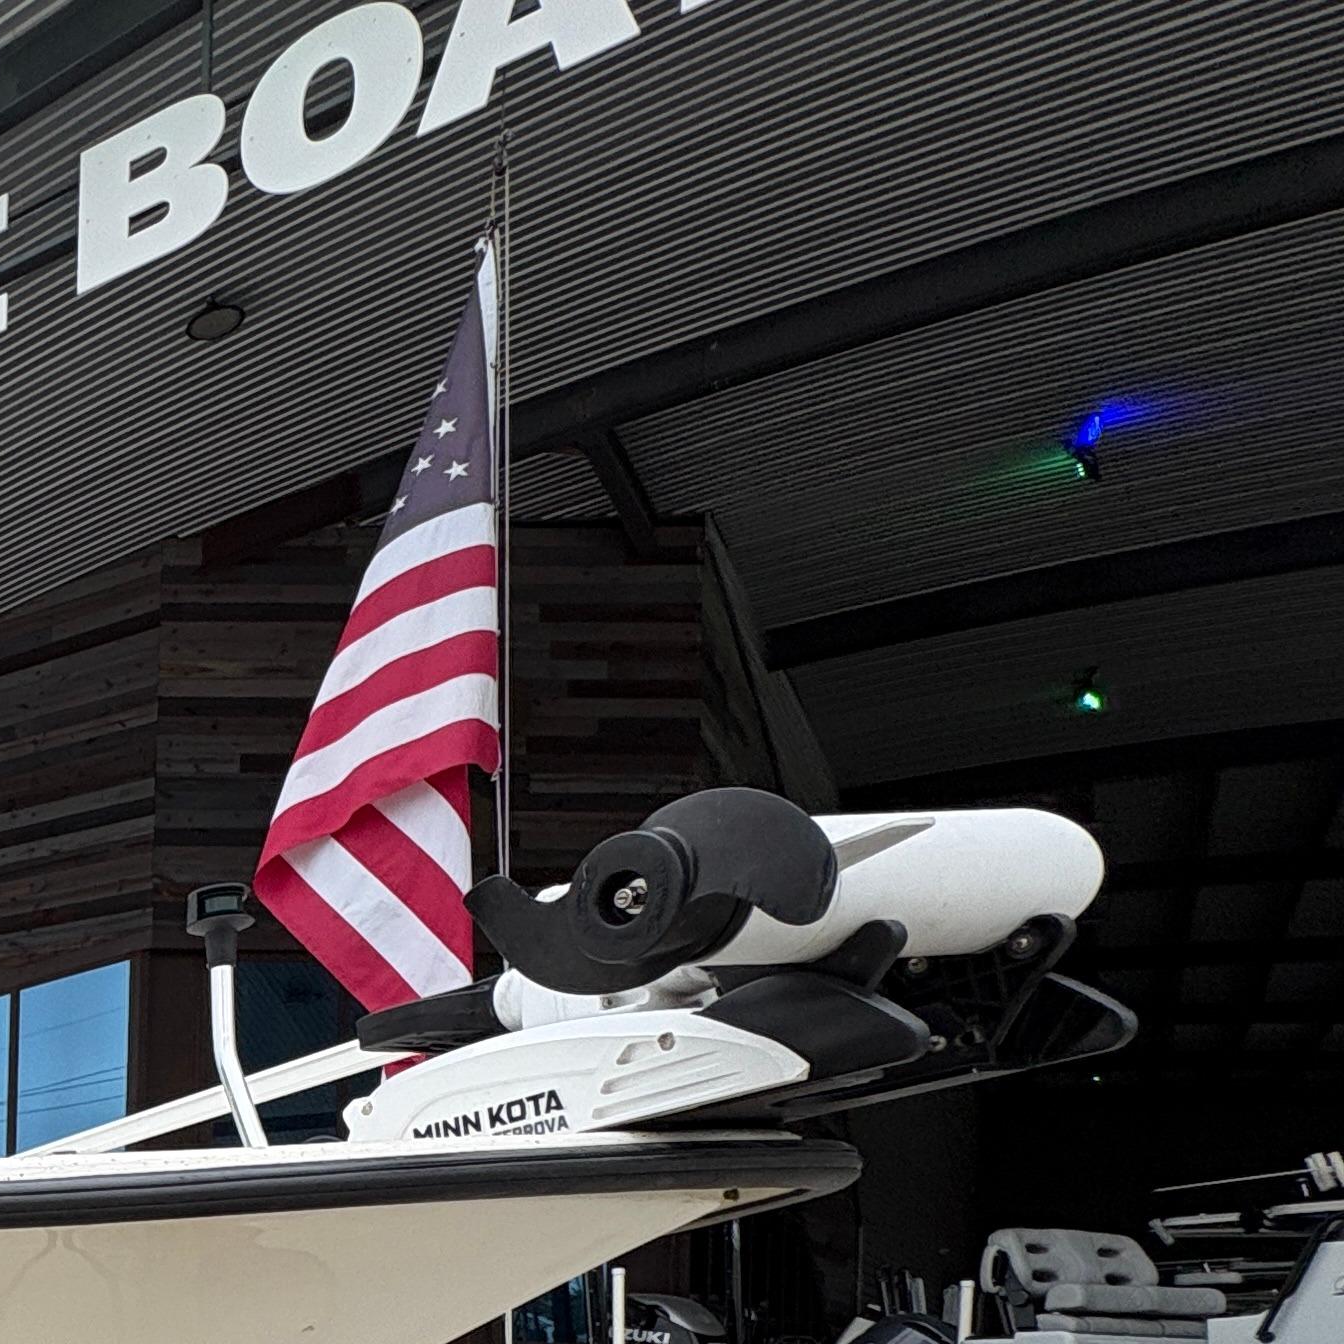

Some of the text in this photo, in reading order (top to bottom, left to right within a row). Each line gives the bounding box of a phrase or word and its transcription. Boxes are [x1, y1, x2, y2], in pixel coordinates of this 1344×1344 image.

[77, 0, 708, 295] BOA
[413, 1089, 564, 1138] MINN KOTA
[492, 1115, 569, 1136] RROVA
[609, 1327, 671, 1344] ZUKI
